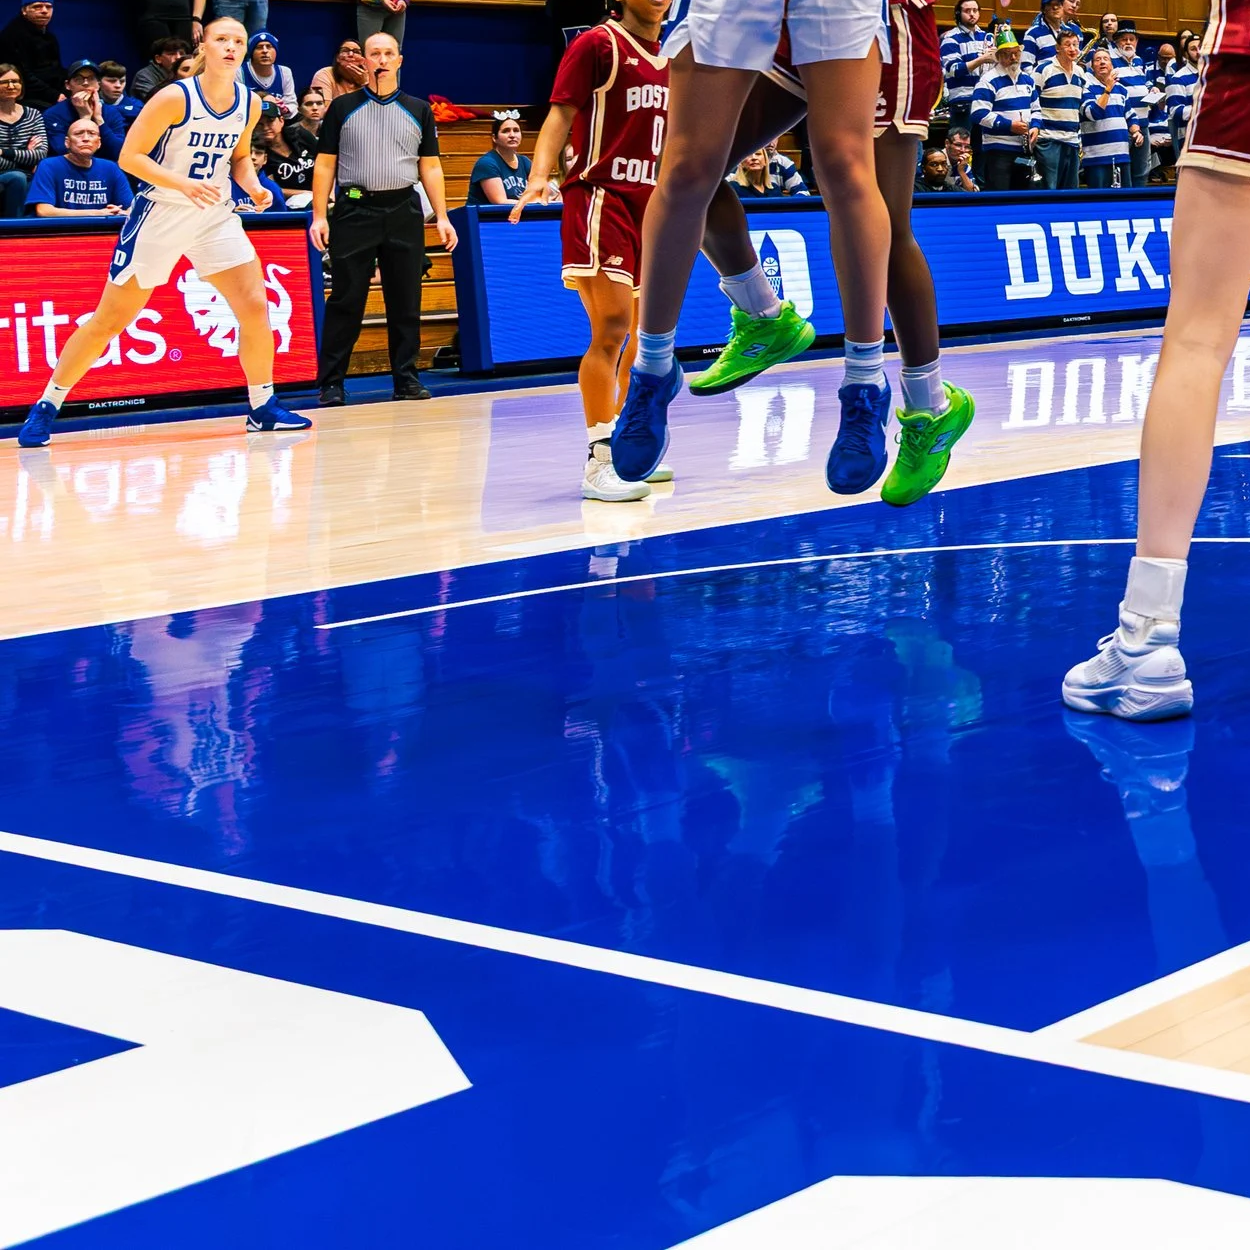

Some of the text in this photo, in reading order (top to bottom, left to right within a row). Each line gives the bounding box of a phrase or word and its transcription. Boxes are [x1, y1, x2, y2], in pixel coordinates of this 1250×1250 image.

[626, 84, 670, 112] BOST
[187, 131, 239, 150] DUKE
[277, 157, 315, 180] Duke
[610, 157, 660, 187] COLL
[503, 176, 528, 190] DUK
[64, 191, 108, 205] CAROLINA
[997, 213, 1172, 301] DUK
[88, 397, 146, 410] DAKTRONICS
